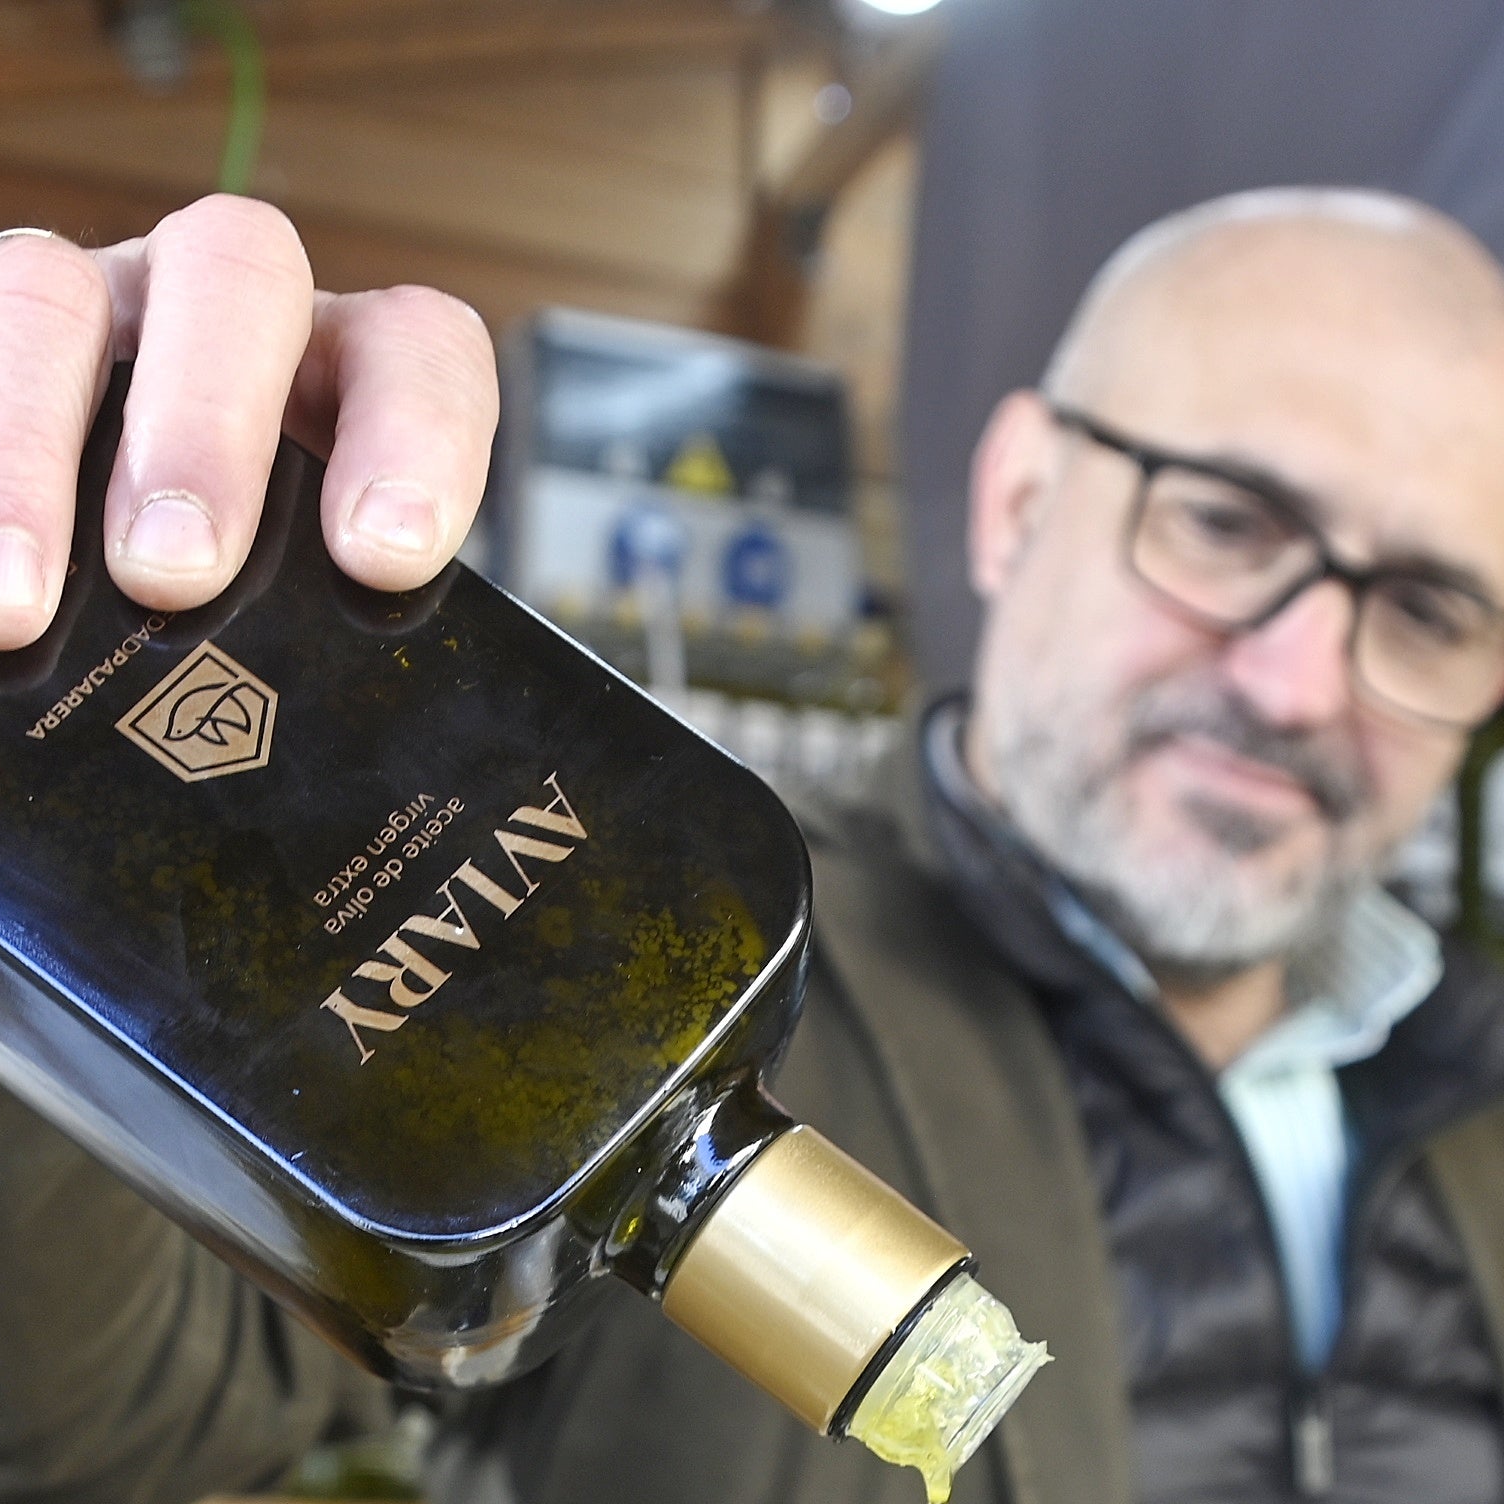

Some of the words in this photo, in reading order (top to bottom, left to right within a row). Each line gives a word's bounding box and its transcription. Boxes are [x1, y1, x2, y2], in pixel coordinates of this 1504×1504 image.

[25, 611, 177, 740] DADPAJARERA
[366, 792, 435, 856] virgen
[402, 796, 465, 859] aceite
[313, 855, 369, 907] extra
[372, 857, 404, 888] de
[319, 770, 588, 1066] AVIARY
[323, 886, 374, 935] oliva
